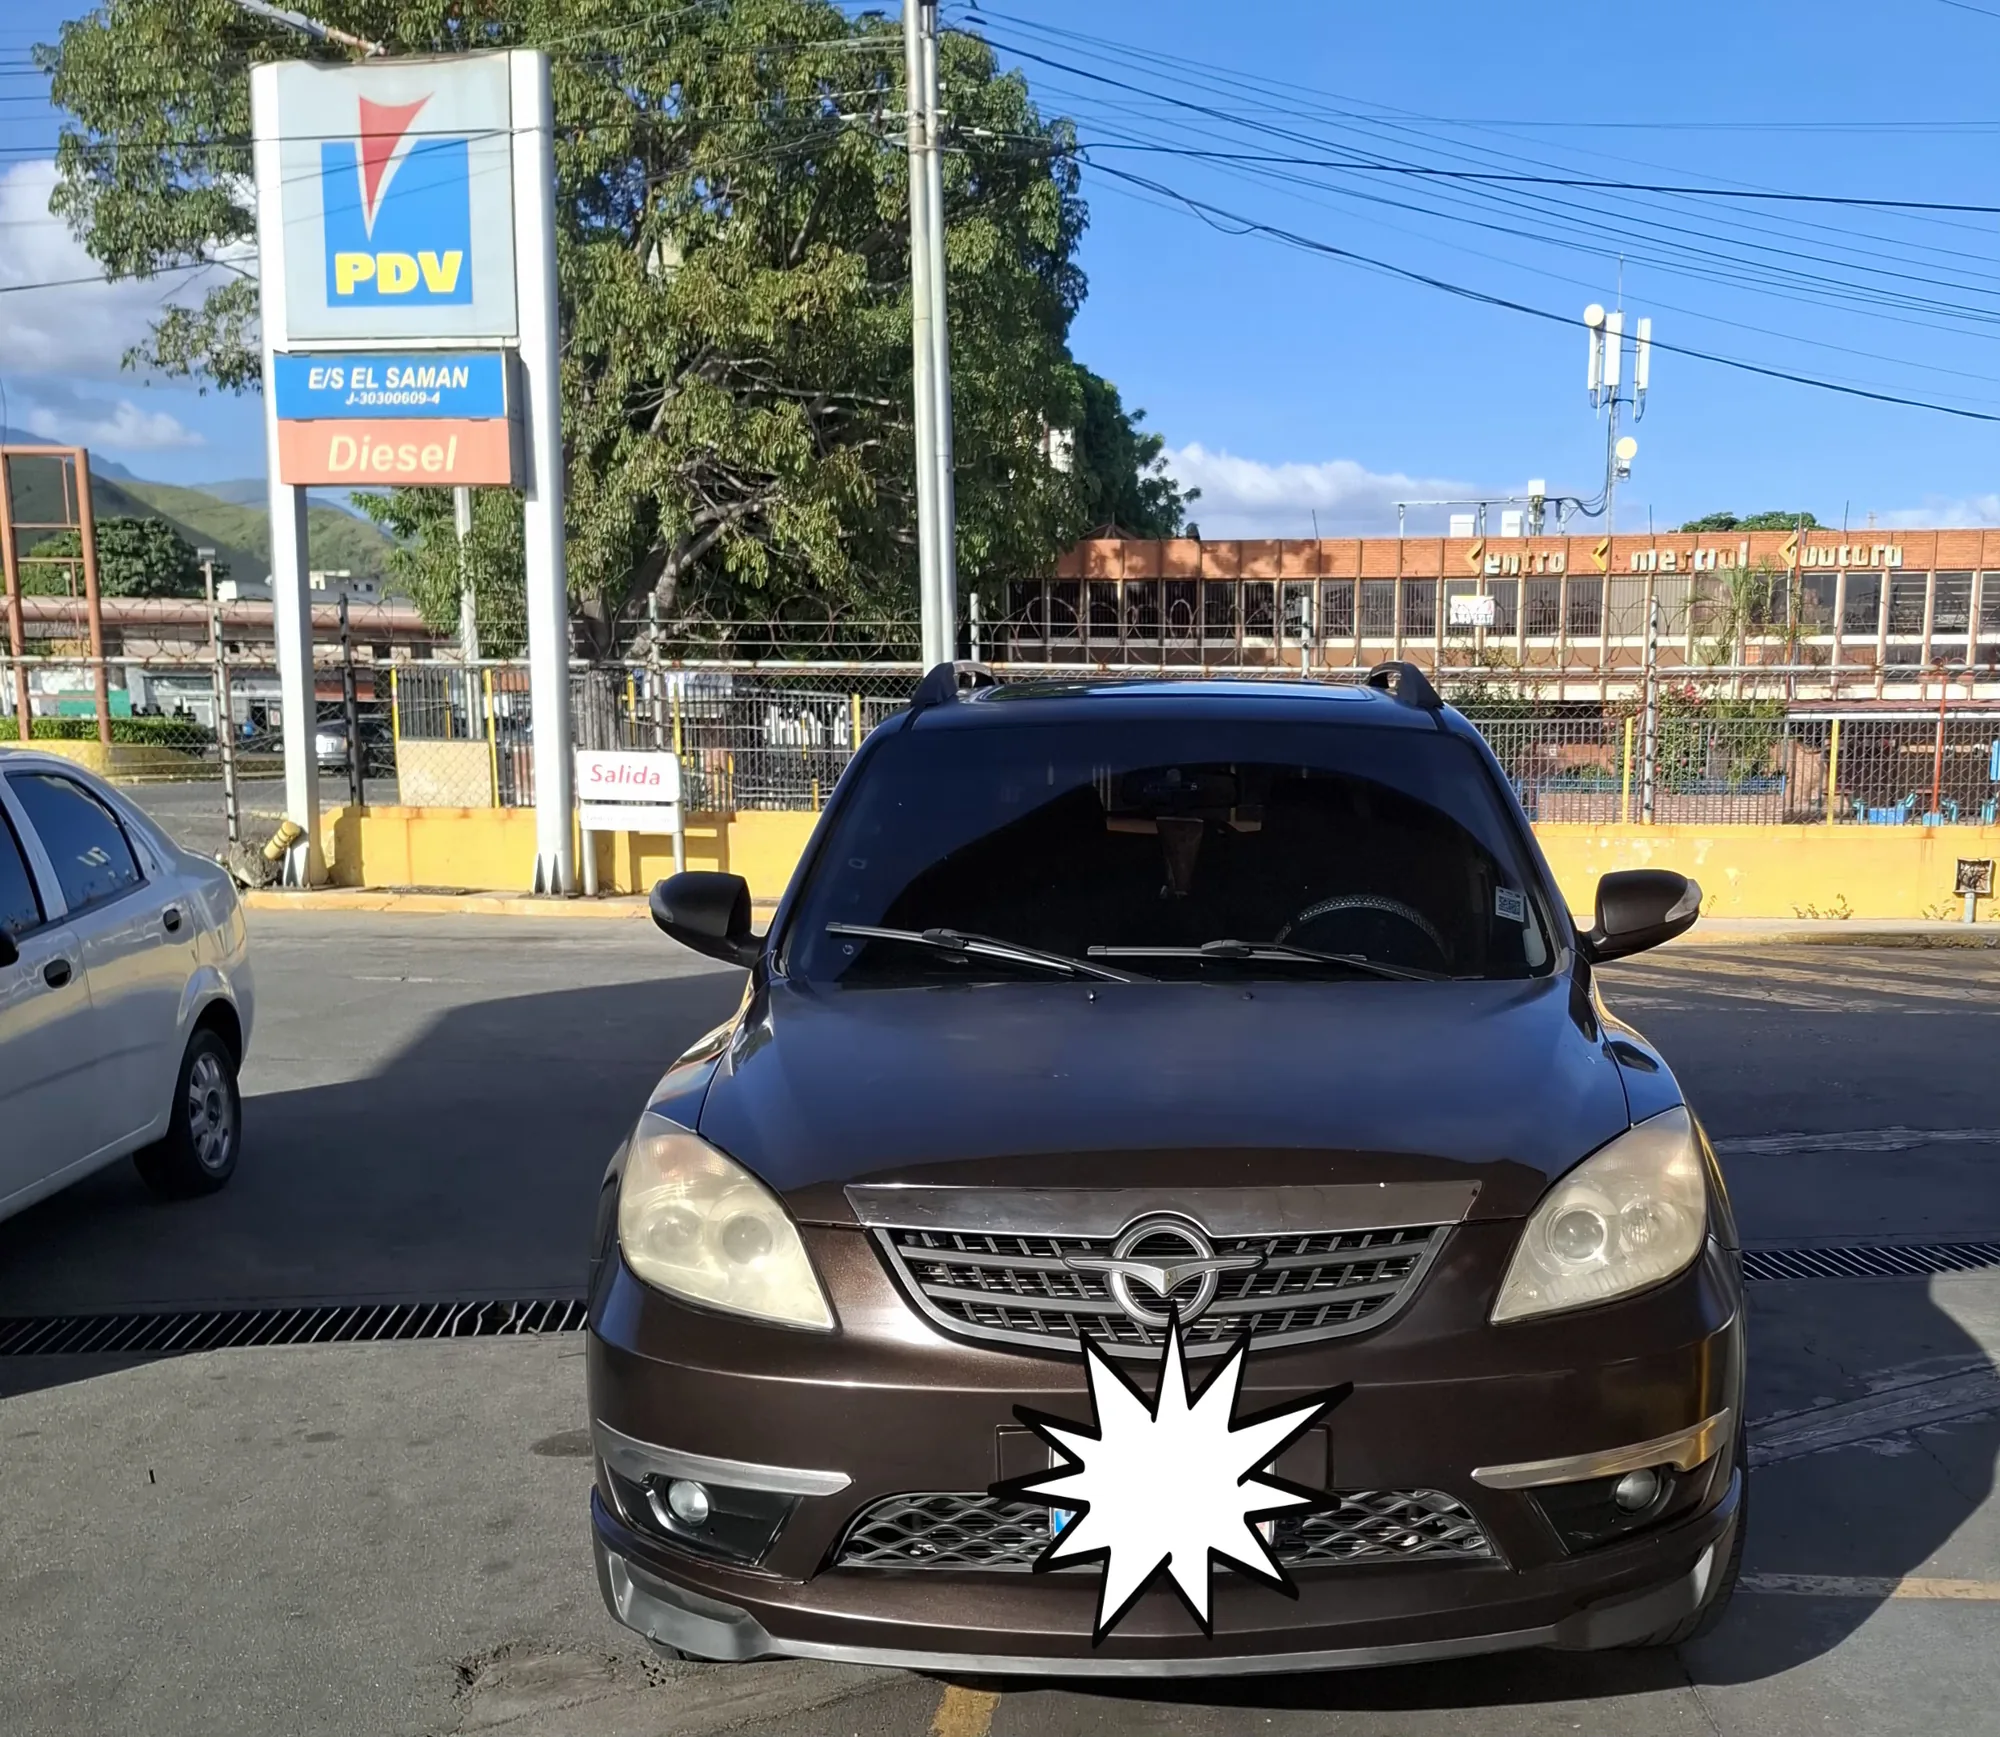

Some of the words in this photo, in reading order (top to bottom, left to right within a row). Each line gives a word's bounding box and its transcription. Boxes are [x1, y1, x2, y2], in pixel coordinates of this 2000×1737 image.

[335, 250, 463, 294] PDV
[308, 367, 344, 390] E/S
[351, 366, 379, 389] EL
[385, 365, 470, 389] SAMAN
[328, 434, 458, 473] Diesel
[590, 764, 661, 786] Salida
